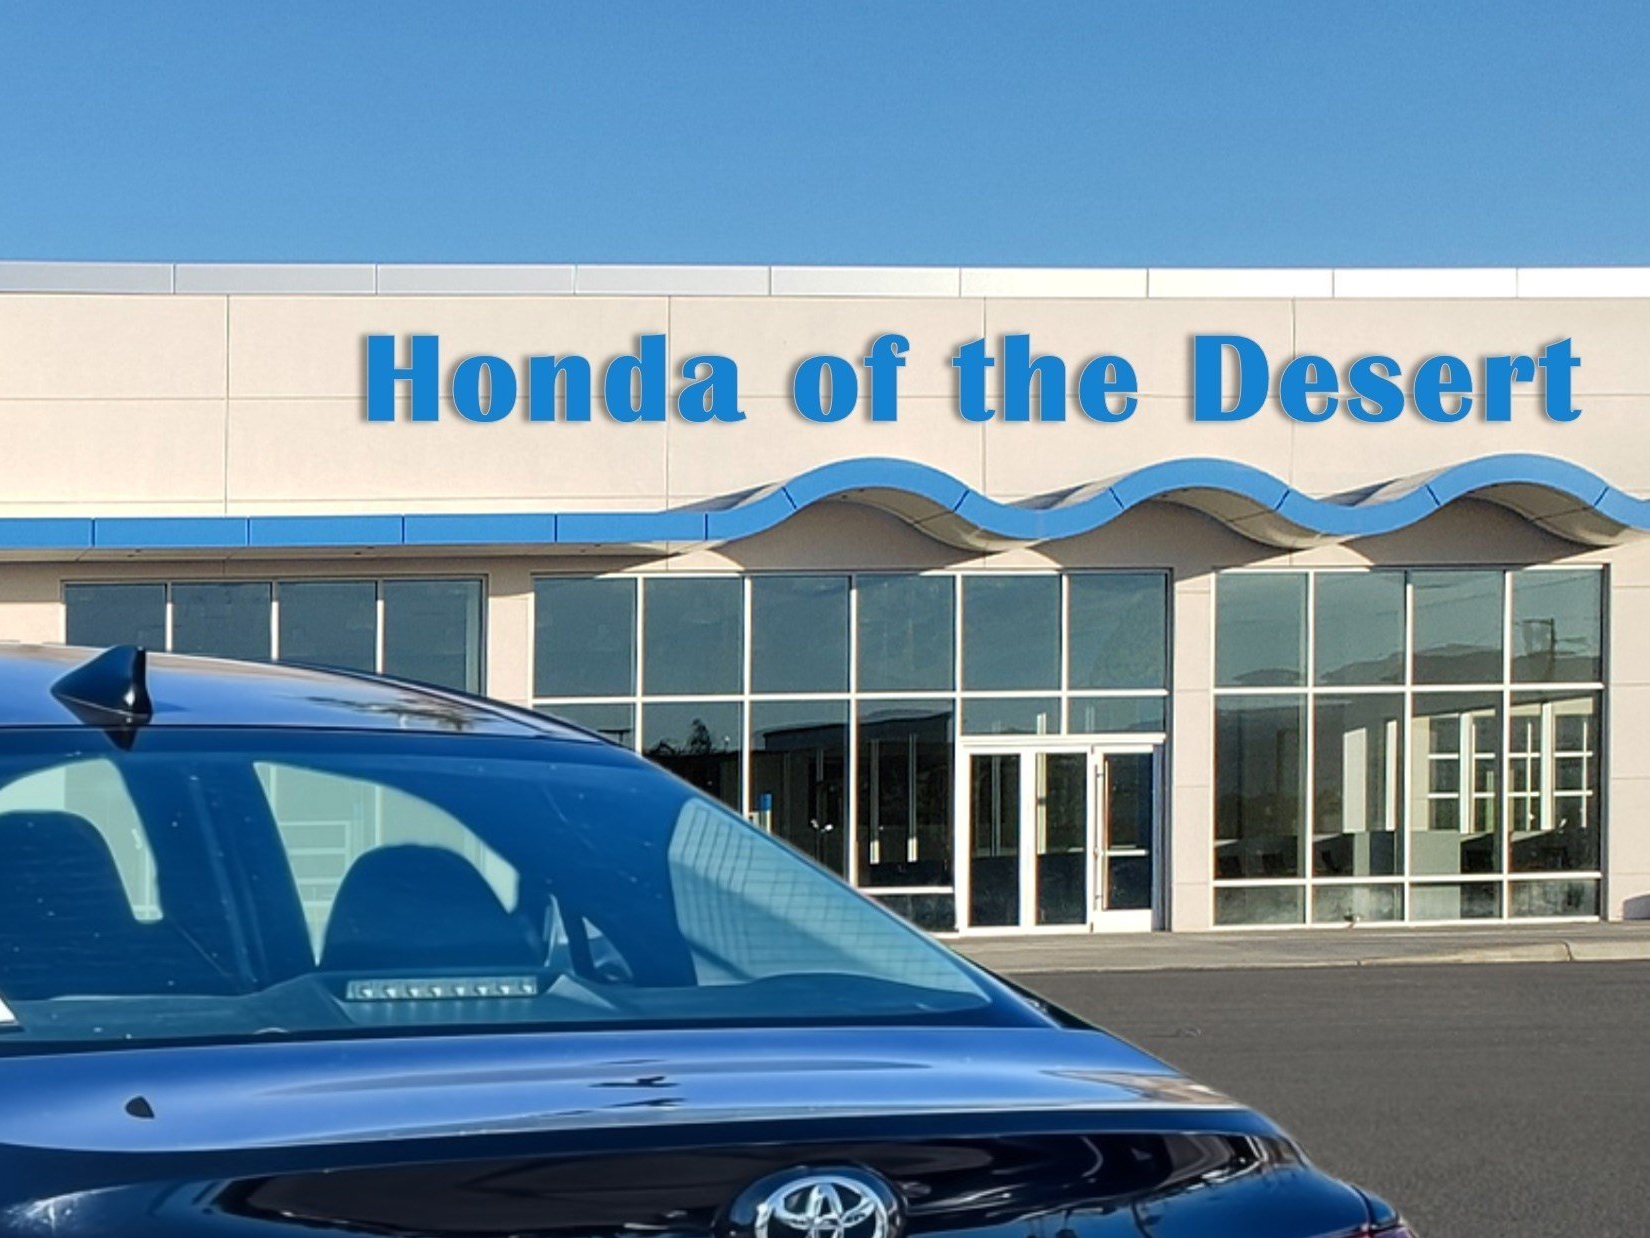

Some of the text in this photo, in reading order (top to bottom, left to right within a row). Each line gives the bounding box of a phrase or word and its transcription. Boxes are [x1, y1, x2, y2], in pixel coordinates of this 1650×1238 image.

[367, 333, 1582, 423] Honda of the Desert
